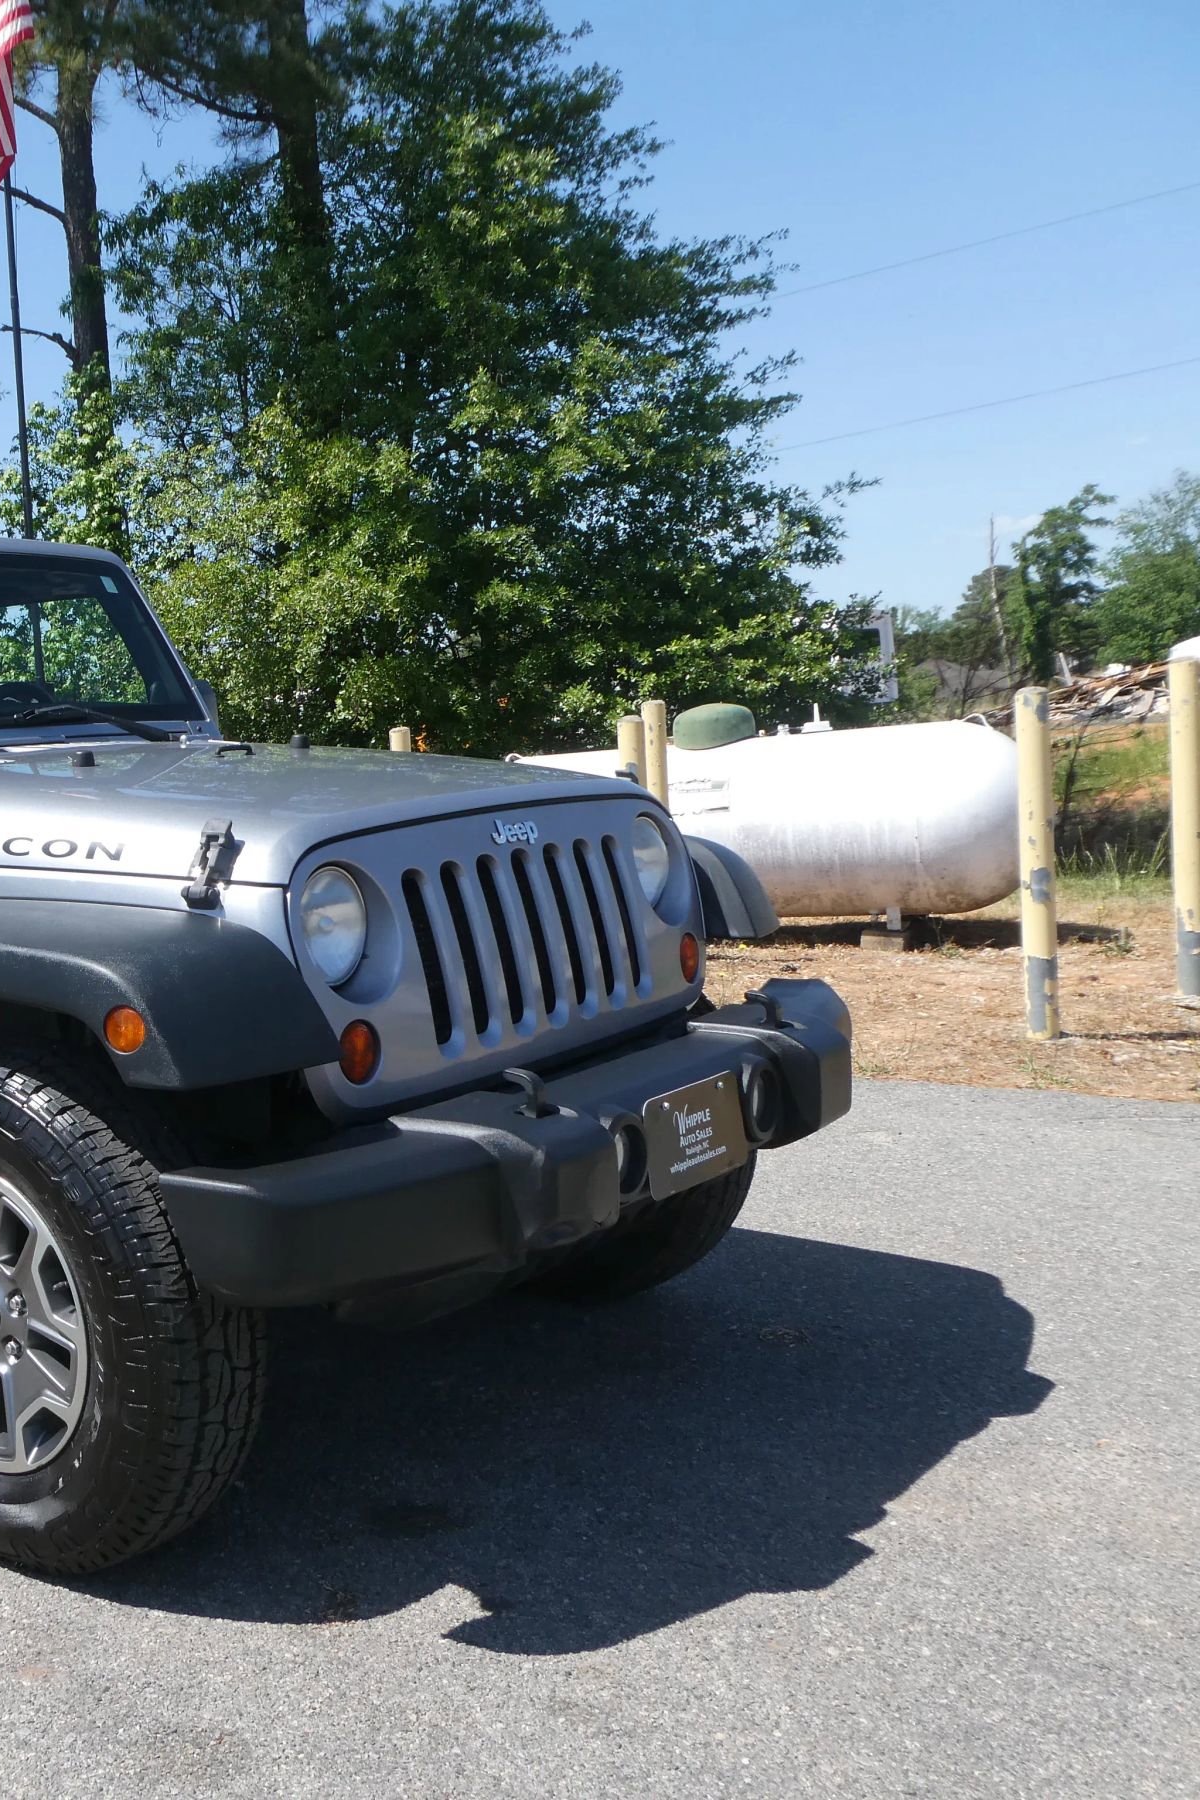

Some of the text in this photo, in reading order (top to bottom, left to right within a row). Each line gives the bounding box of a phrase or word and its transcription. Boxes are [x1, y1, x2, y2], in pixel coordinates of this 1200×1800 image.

[491, 819, 538, 845] Jeep
[673, 1104, 711, 1135] WHIPPLE
[680, 1127, 713, 1148] AUTO SALES
